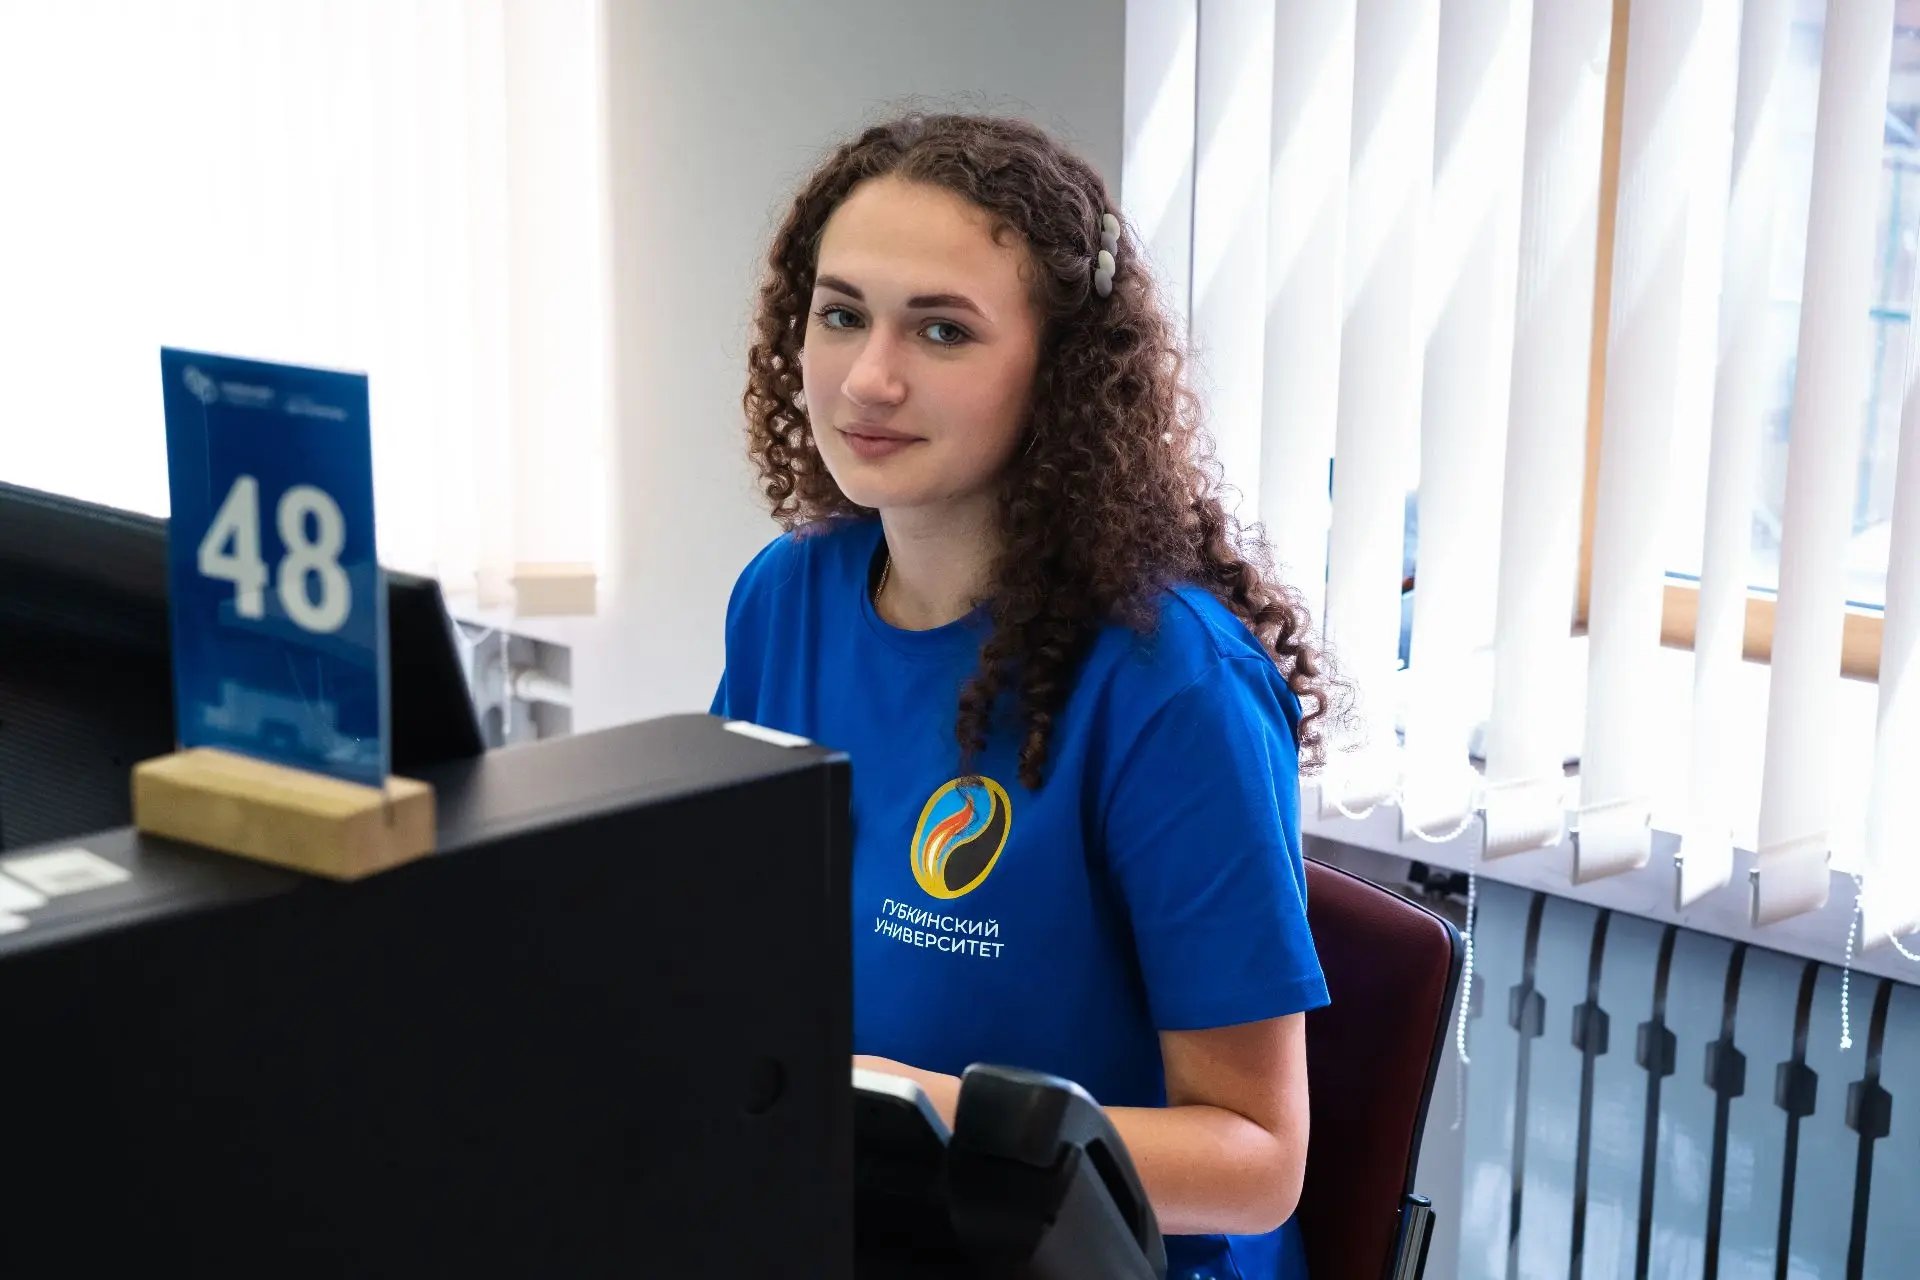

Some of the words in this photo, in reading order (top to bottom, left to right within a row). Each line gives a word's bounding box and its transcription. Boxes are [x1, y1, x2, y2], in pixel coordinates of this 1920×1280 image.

[197, 474, 352, 634] 48
[874, 917, 1005, 958] УНИВЕРСИТЕТ
[882, 898, 999, 938] ГУБКИНСКИЙ
